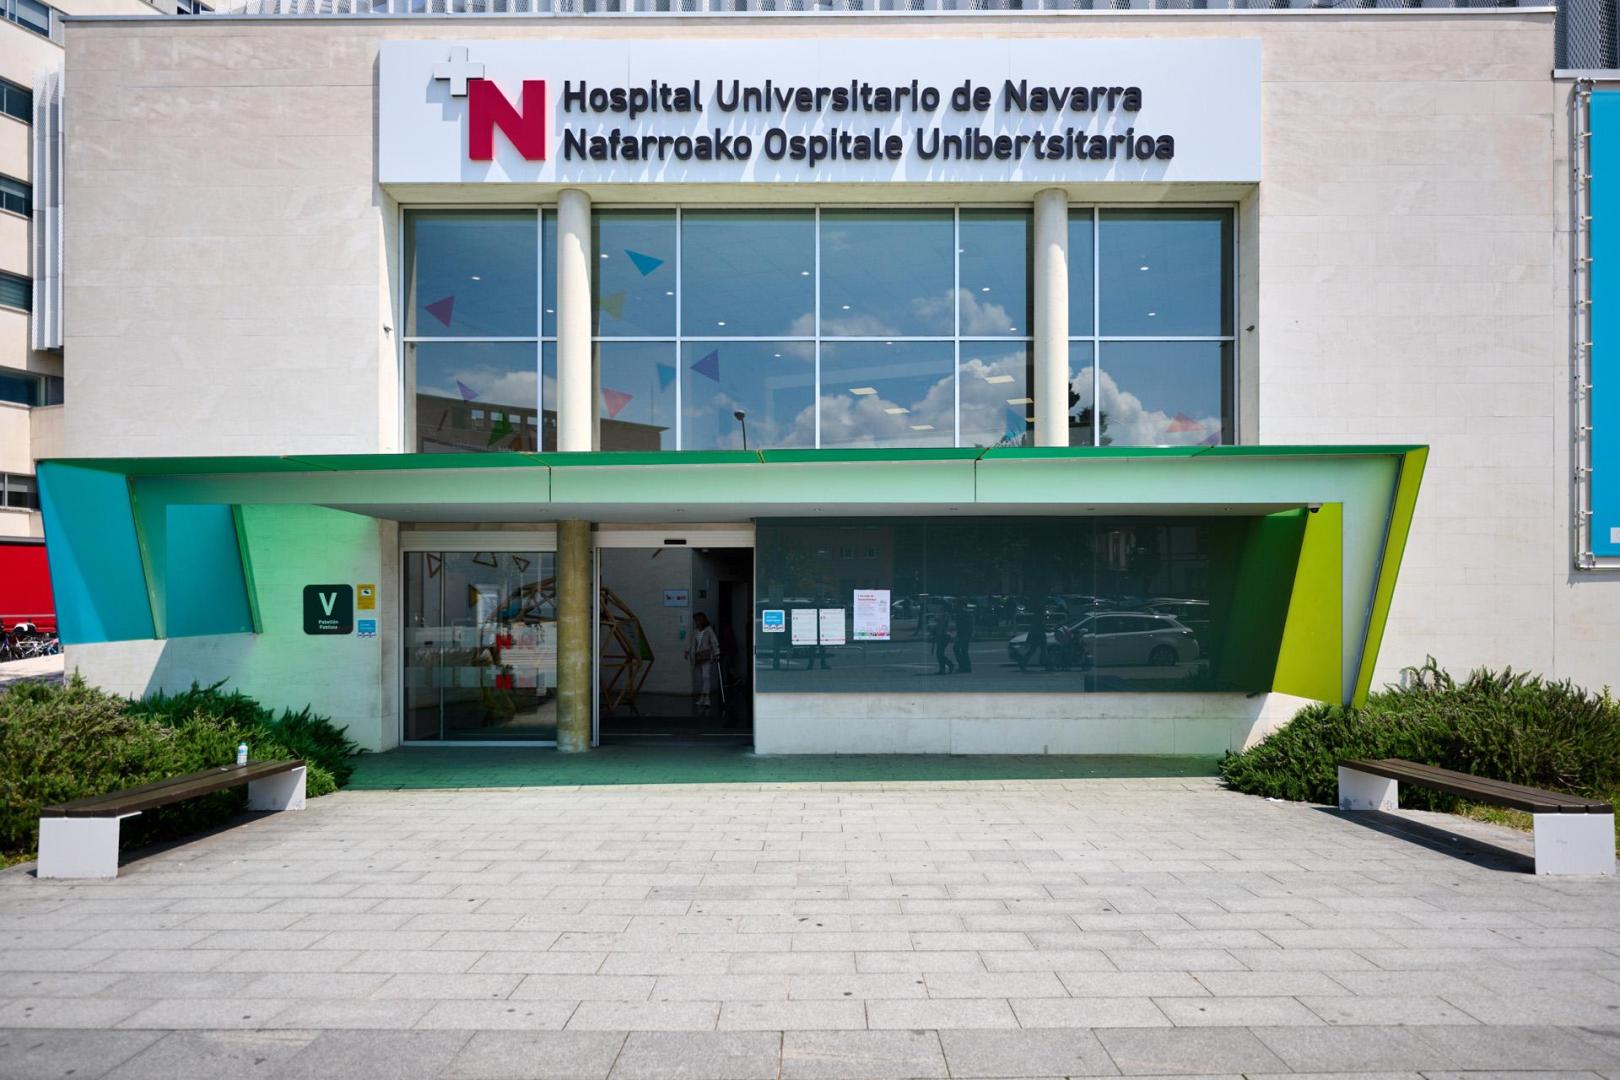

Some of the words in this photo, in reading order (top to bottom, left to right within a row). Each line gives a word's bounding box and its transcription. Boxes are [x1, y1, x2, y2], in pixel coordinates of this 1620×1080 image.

[564, 79, 703, 120] Hospital
[716, 79, 940, 112] Universitario
[951, 79, 992, 112] de
[1004, 79, 1142, 112] Navarra
[468, 79, 546, 161] N
[564, 127, 753, 160] Nafarroako
[764, 127, 903, 166] Ospitale
[916, 127, 1175, 160] Unibertsitarioa
[318, 593, 338, 616] V
